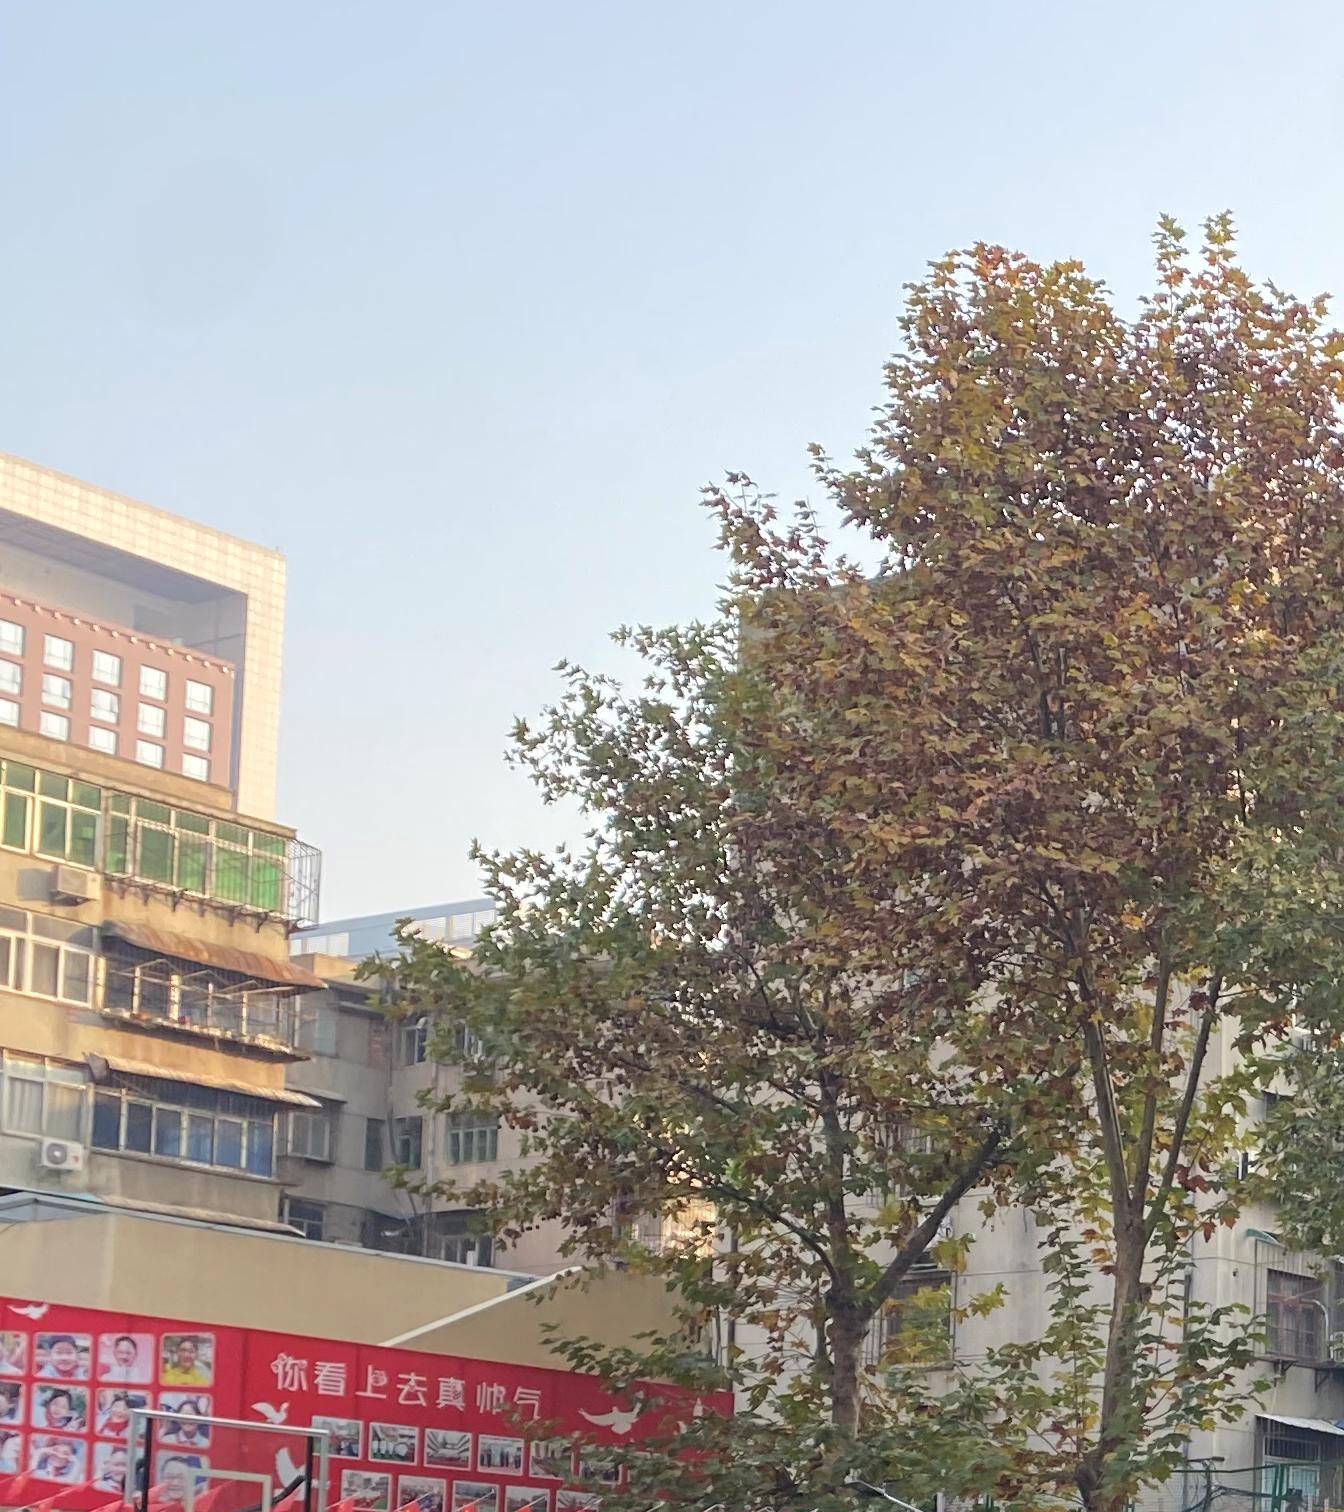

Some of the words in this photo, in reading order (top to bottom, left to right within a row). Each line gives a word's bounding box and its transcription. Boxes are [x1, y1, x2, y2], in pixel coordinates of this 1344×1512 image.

[270, 1352, 542, 1420] 你看上去真帅气
